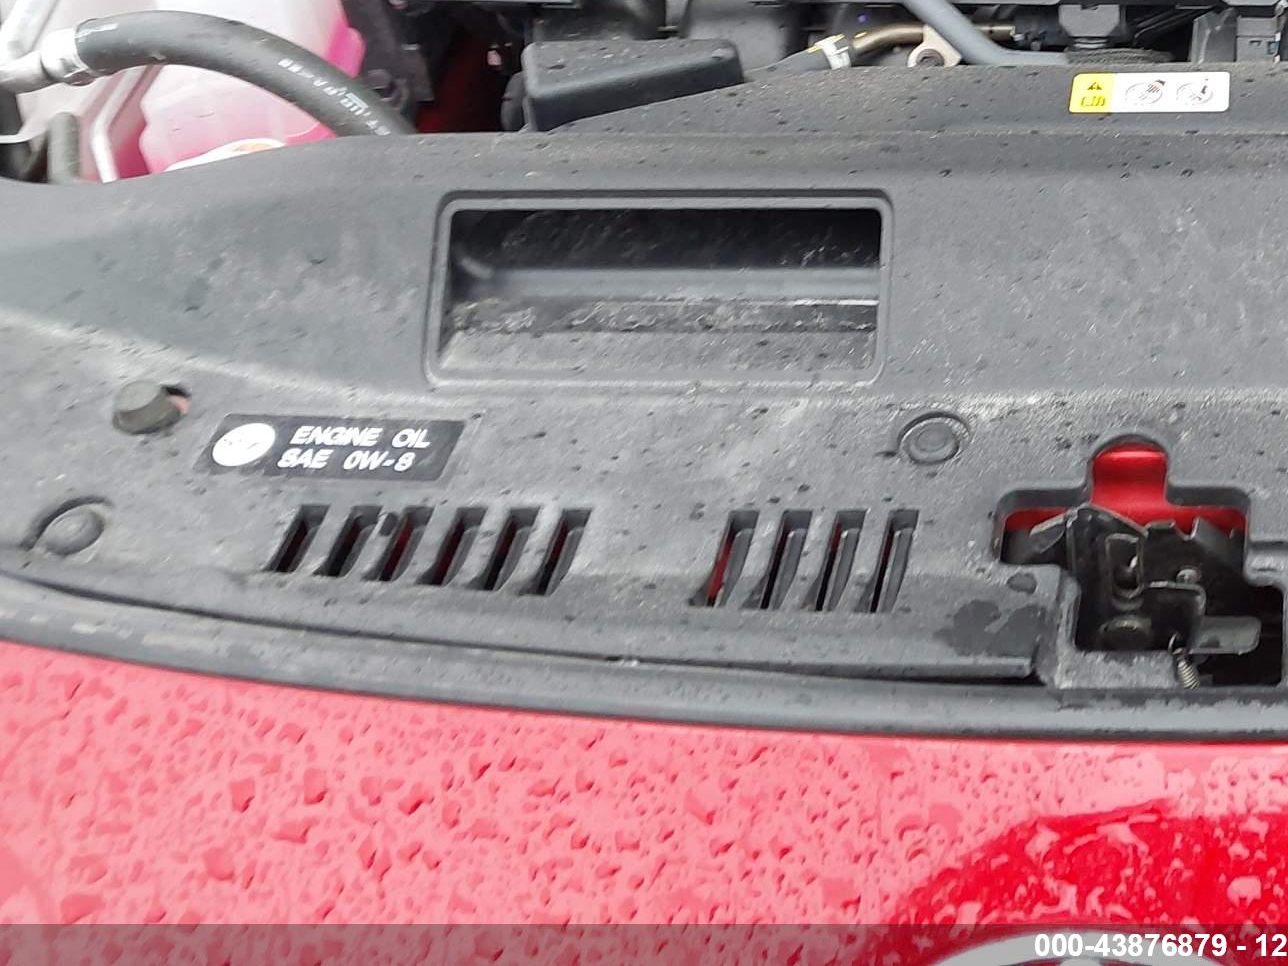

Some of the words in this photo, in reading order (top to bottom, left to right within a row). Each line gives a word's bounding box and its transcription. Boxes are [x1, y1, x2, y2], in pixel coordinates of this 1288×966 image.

[289, 425, 383, 447] ENGINE
[391, 428, 431, 449] OIL
[277, 447, 334, 469] SAE
[343, 450, 416, 472] 0W-8
